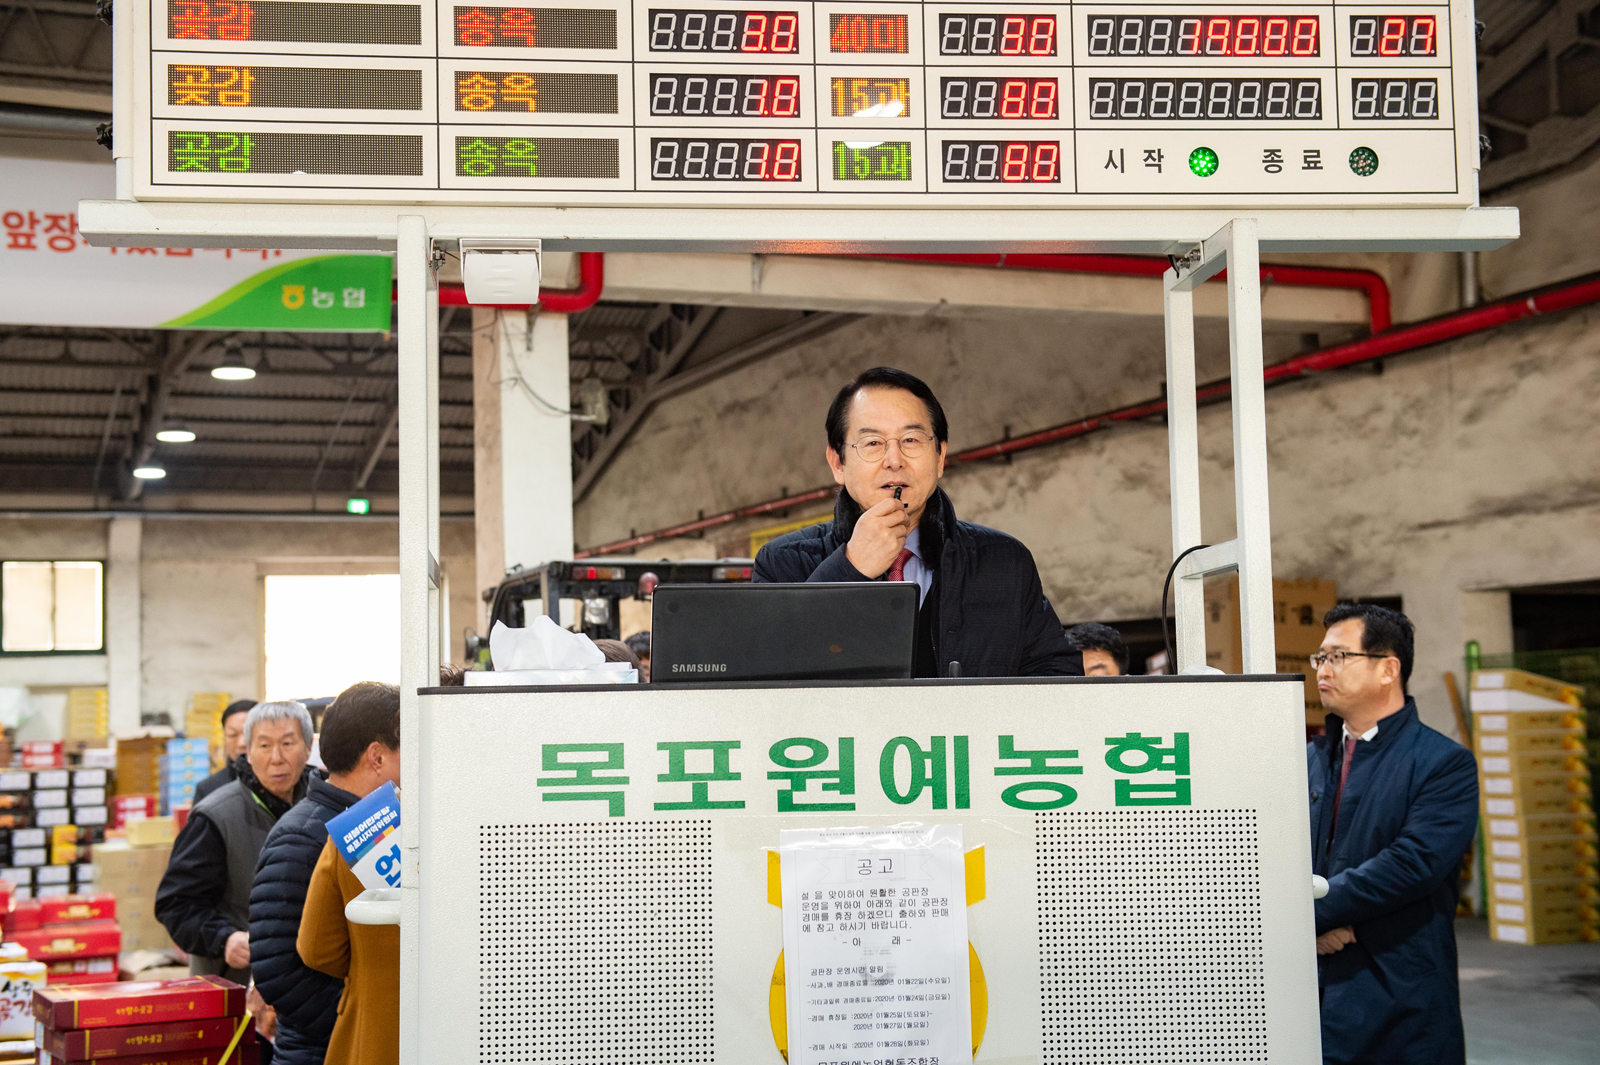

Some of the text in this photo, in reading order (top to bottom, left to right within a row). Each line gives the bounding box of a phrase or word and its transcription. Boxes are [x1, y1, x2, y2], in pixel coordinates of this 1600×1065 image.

[172, 1, 255, 40] 곶감
[457, 7, 537, 48] 송옥
[172, 65, 255, 106] 곶감
[458, 73, 538, 113] 송옥
[174, 131, 255, 173] 곶감
[460, 138, 539, 178] 송옥
[311, 286, 366, 310] 농협
[671, 663, 728, 673] SAMSUNG
[536, 731, 1192, 818] 목포원예농협
[828, 889, 865, 899] 맞이하여
[869, 888, 896, 898] 원활한
[902, 887, 929, 897] 공판장
[802, 897, 948, 911] 운영을 위하여 아래와 같이 공판장
[802, 908, 949, 922] 경매를 휴장 하겠으니 출하와 판매
[802, 924, 811, 933] 에
[840, 921, 866, 931] 하시기
[871, 920, 912, 930] 바랍니다.
[811, 965, 884, 976] 공판장 운영시간 알림
[853, 1022, 873, 1031] 2020년
